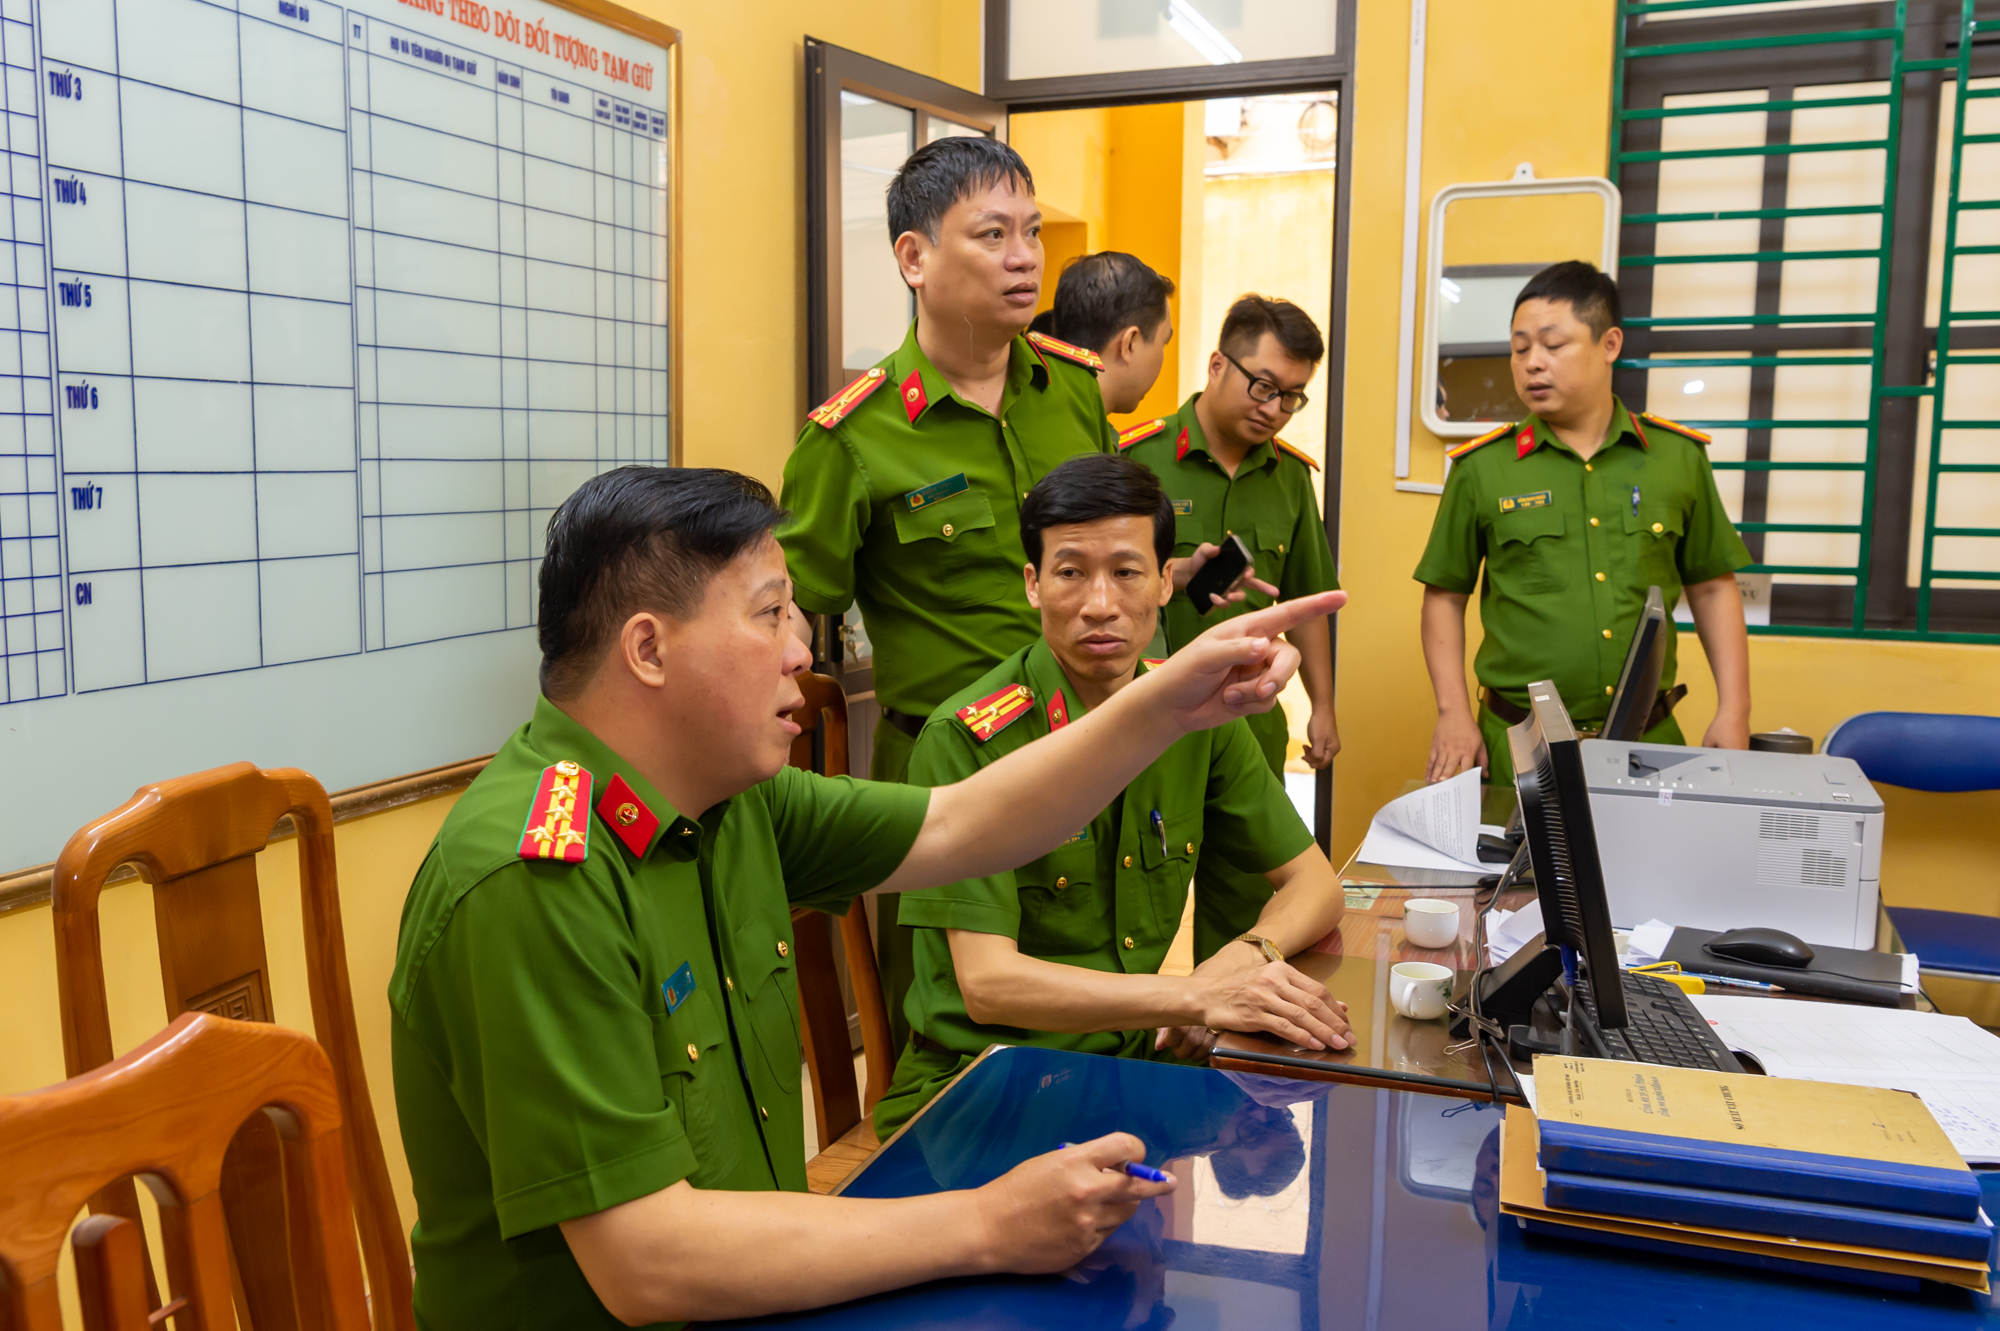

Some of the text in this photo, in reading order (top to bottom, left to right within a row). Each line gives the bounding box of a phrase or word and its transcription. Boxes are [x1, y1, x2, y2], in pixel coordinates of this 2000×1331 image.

[448, 0, 490, 32] THEO
[525, 17, 550, 55] ĐỐI
[553, 33, 599, 71] TƯỢNG
[602, 51, 630, 83] TẠM
[49, 68, 82, 101] THỨ 3
[54, 175, 87, 205] THỨ 4
[58, 277, 92, 308] THỨ 5
[66, 379, 98, 410] THỨ 6
[71, 481, 103, 510] THỨ 7
[75, 582, 92, 605] CN
